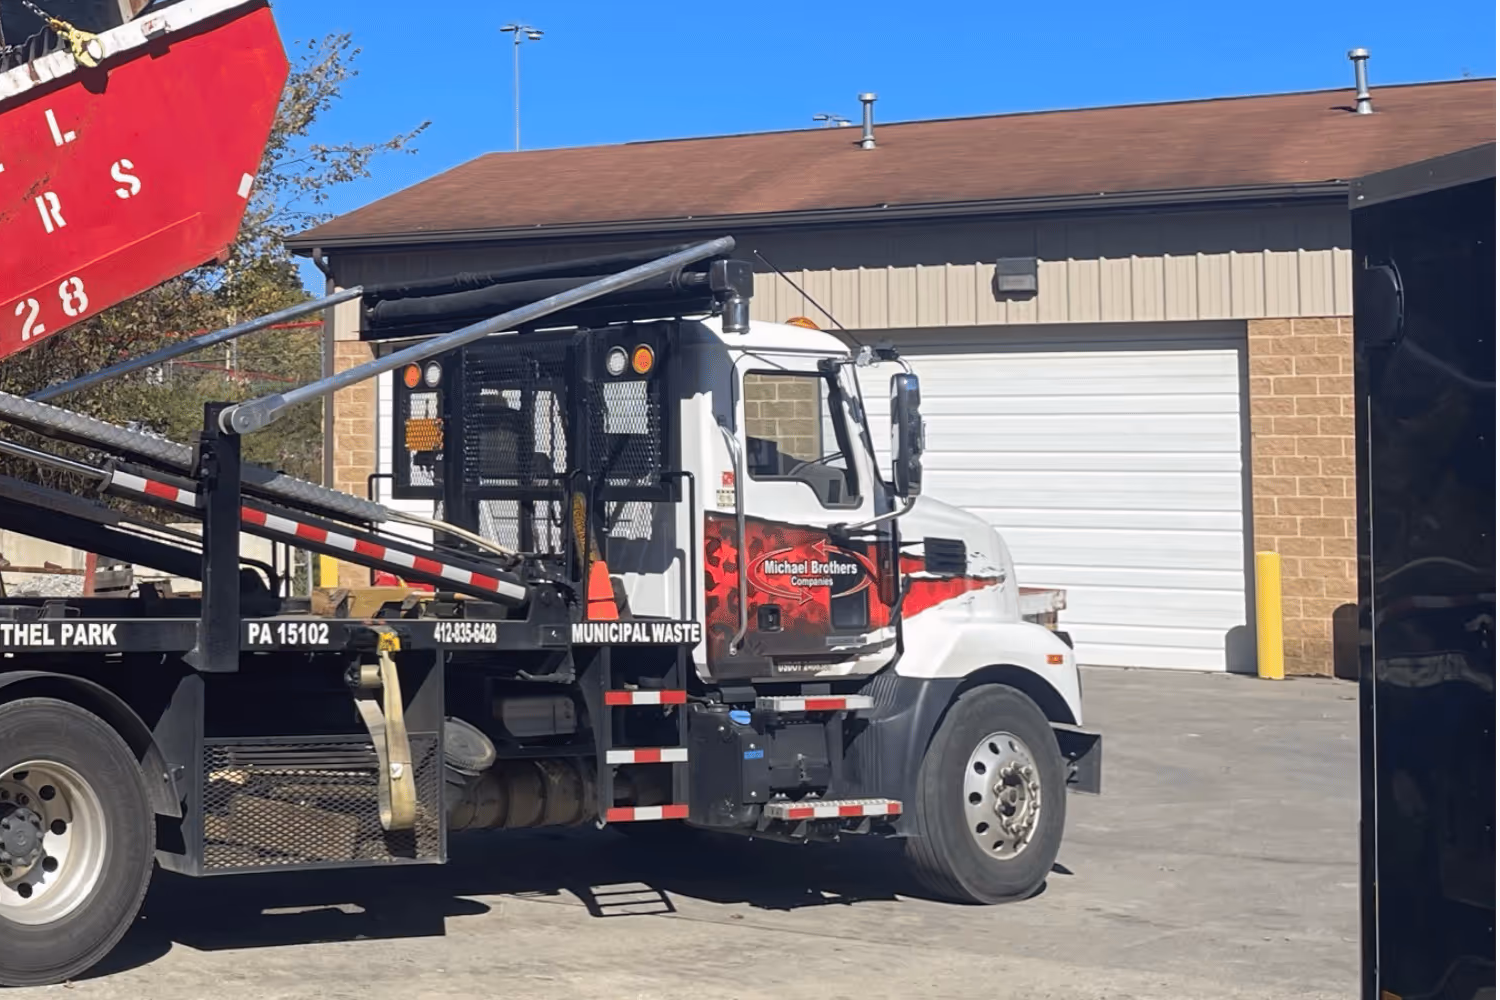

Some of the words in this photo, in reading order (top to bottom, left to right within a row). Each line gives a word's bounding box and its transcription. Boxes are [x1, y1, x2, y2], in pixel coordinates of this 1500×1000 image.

[764, 560, 808, 575] Michael
[810, 560, 858, 575] Brothers
[791, 576, 834, 587] Companies
[61, 623, 117, 646] PARK
[248, 623, 273, 645] PA
[277, 623, 329, 645] 15102
[433, 622, 497, 644] 412-835-6428
[571, 623, 650, 643] MUNICIPAL
[651, 623, 700, 643] WASTE
